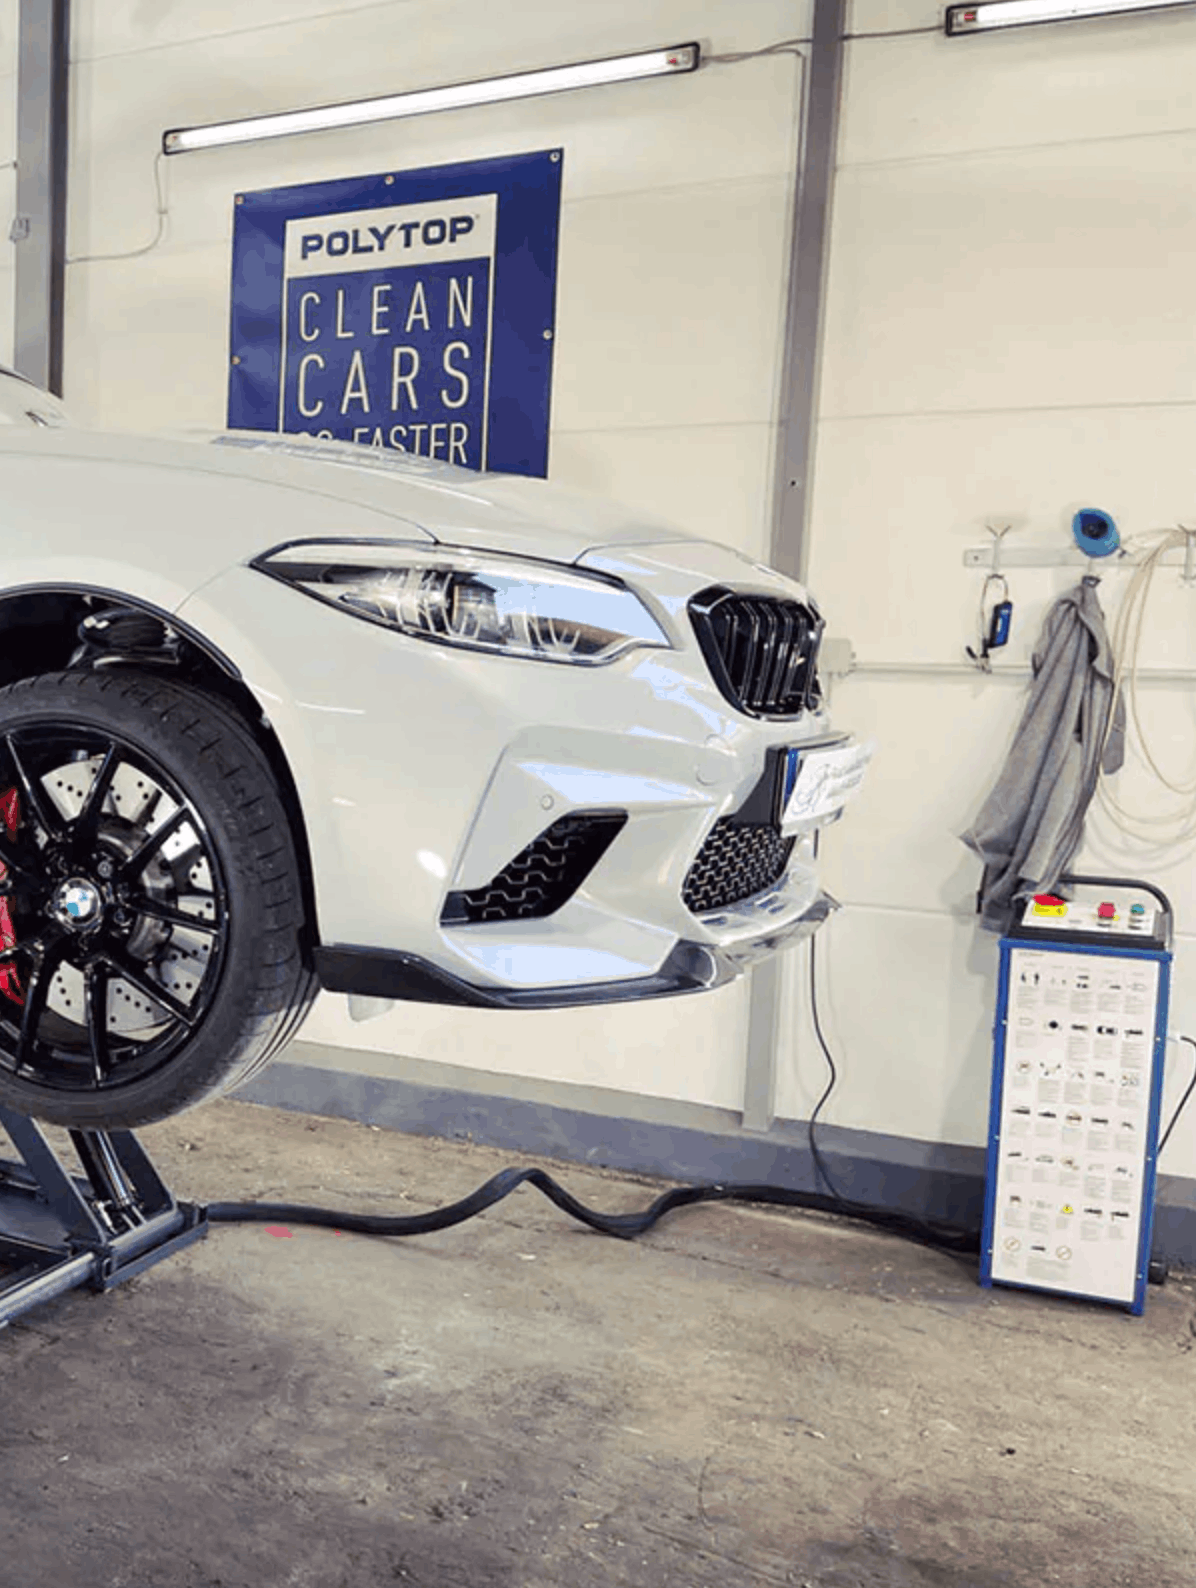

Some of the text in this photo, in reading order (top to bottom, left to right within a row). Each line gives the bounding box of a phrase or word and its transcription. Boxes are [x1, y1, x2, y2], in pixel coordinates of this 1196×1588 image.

[301, 215, 474, 260] POLYTOP
[298, 275, 473, 342] CLEAN
[297, 342, 470, 417] CARS
